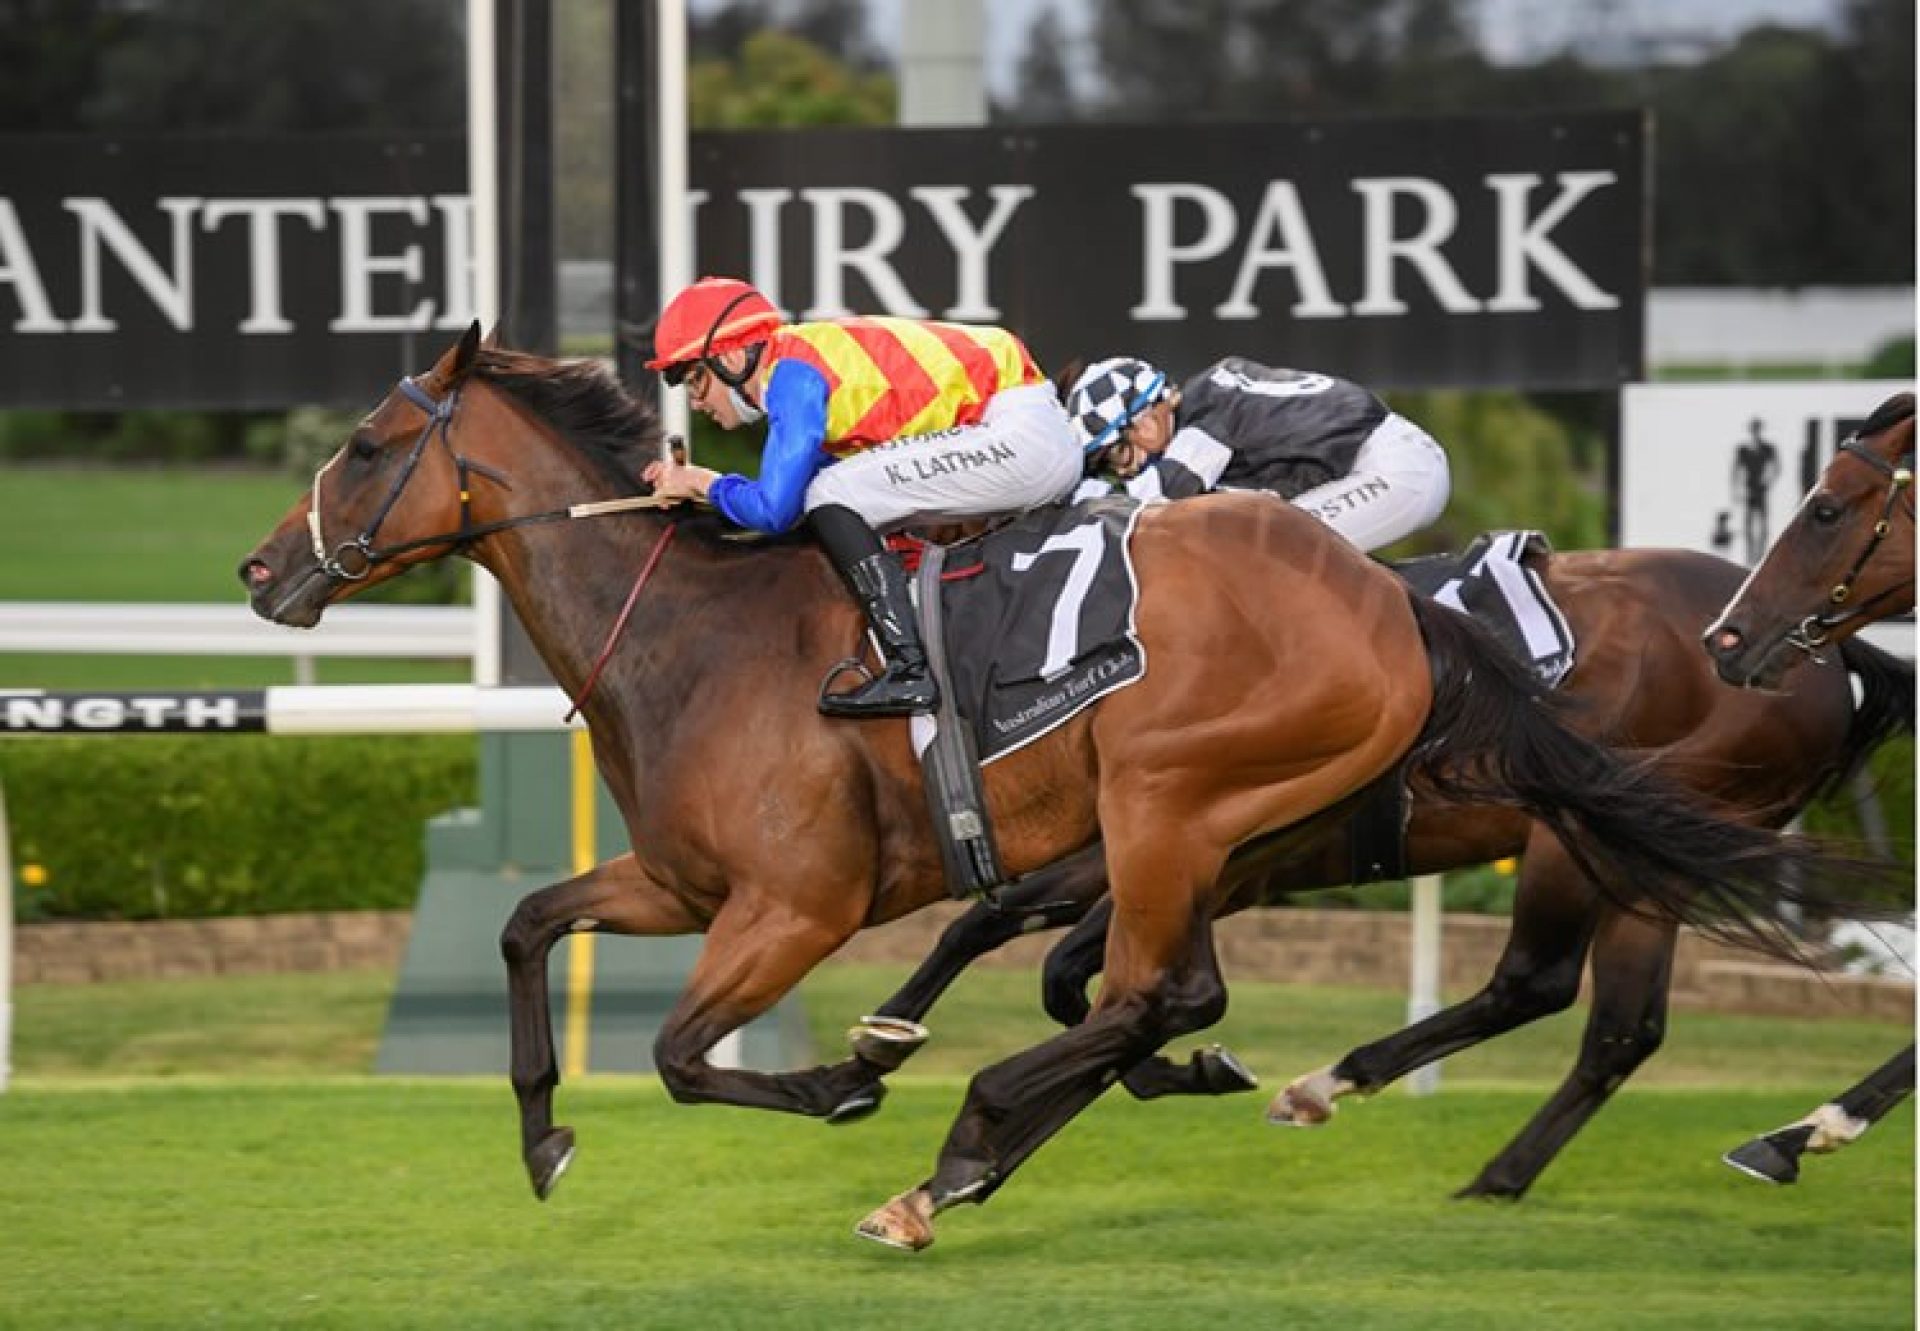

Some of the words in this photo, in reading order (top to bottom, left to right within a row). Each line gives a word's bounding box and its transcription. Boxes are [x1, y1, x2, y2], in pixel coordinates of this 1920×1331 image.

[1131, 172, 1618, 320] PARK
[912, 442, 1015, 480] LATHAM
[1011, 520, 1106, 682] 7
[7, 698, 239, 728] NGTH
